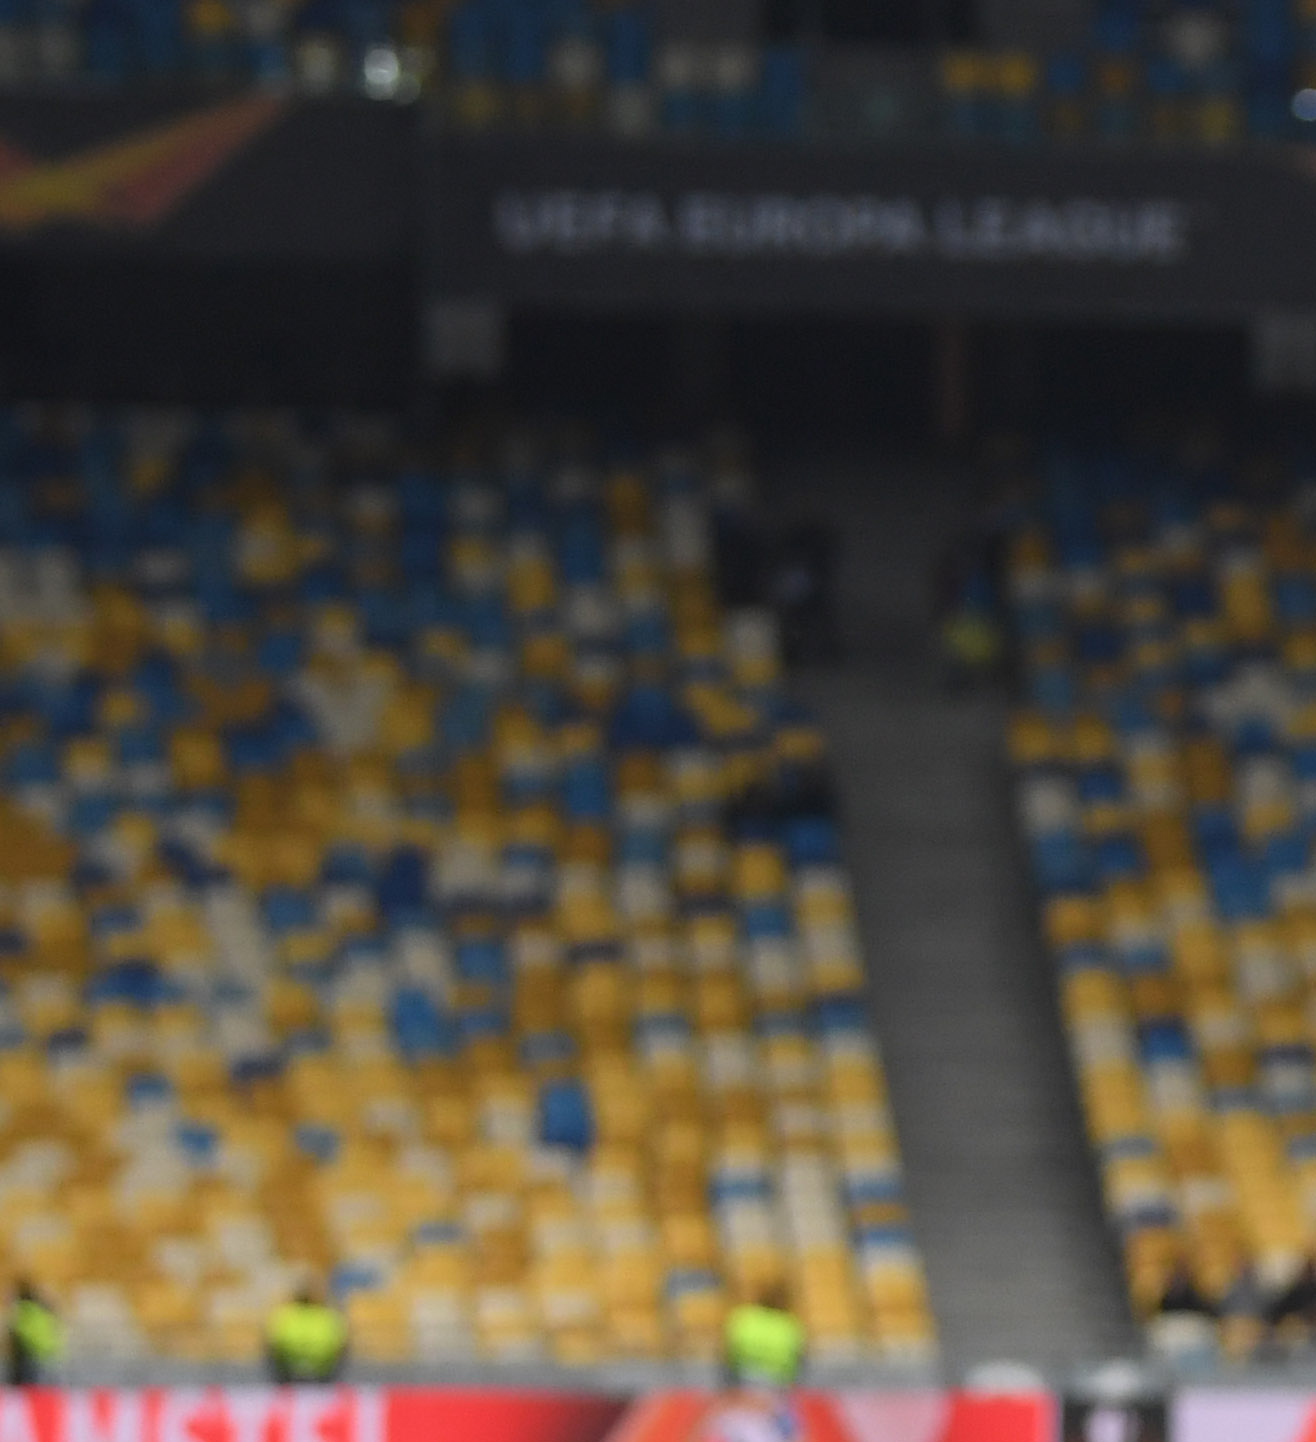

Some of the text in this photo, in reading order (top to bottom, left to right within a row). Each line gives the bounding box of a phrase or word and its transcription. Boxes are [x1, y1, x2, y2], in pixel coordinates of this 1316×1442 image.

[495, 193, 1184, 263] UEFA EUROPA LEAGUE
